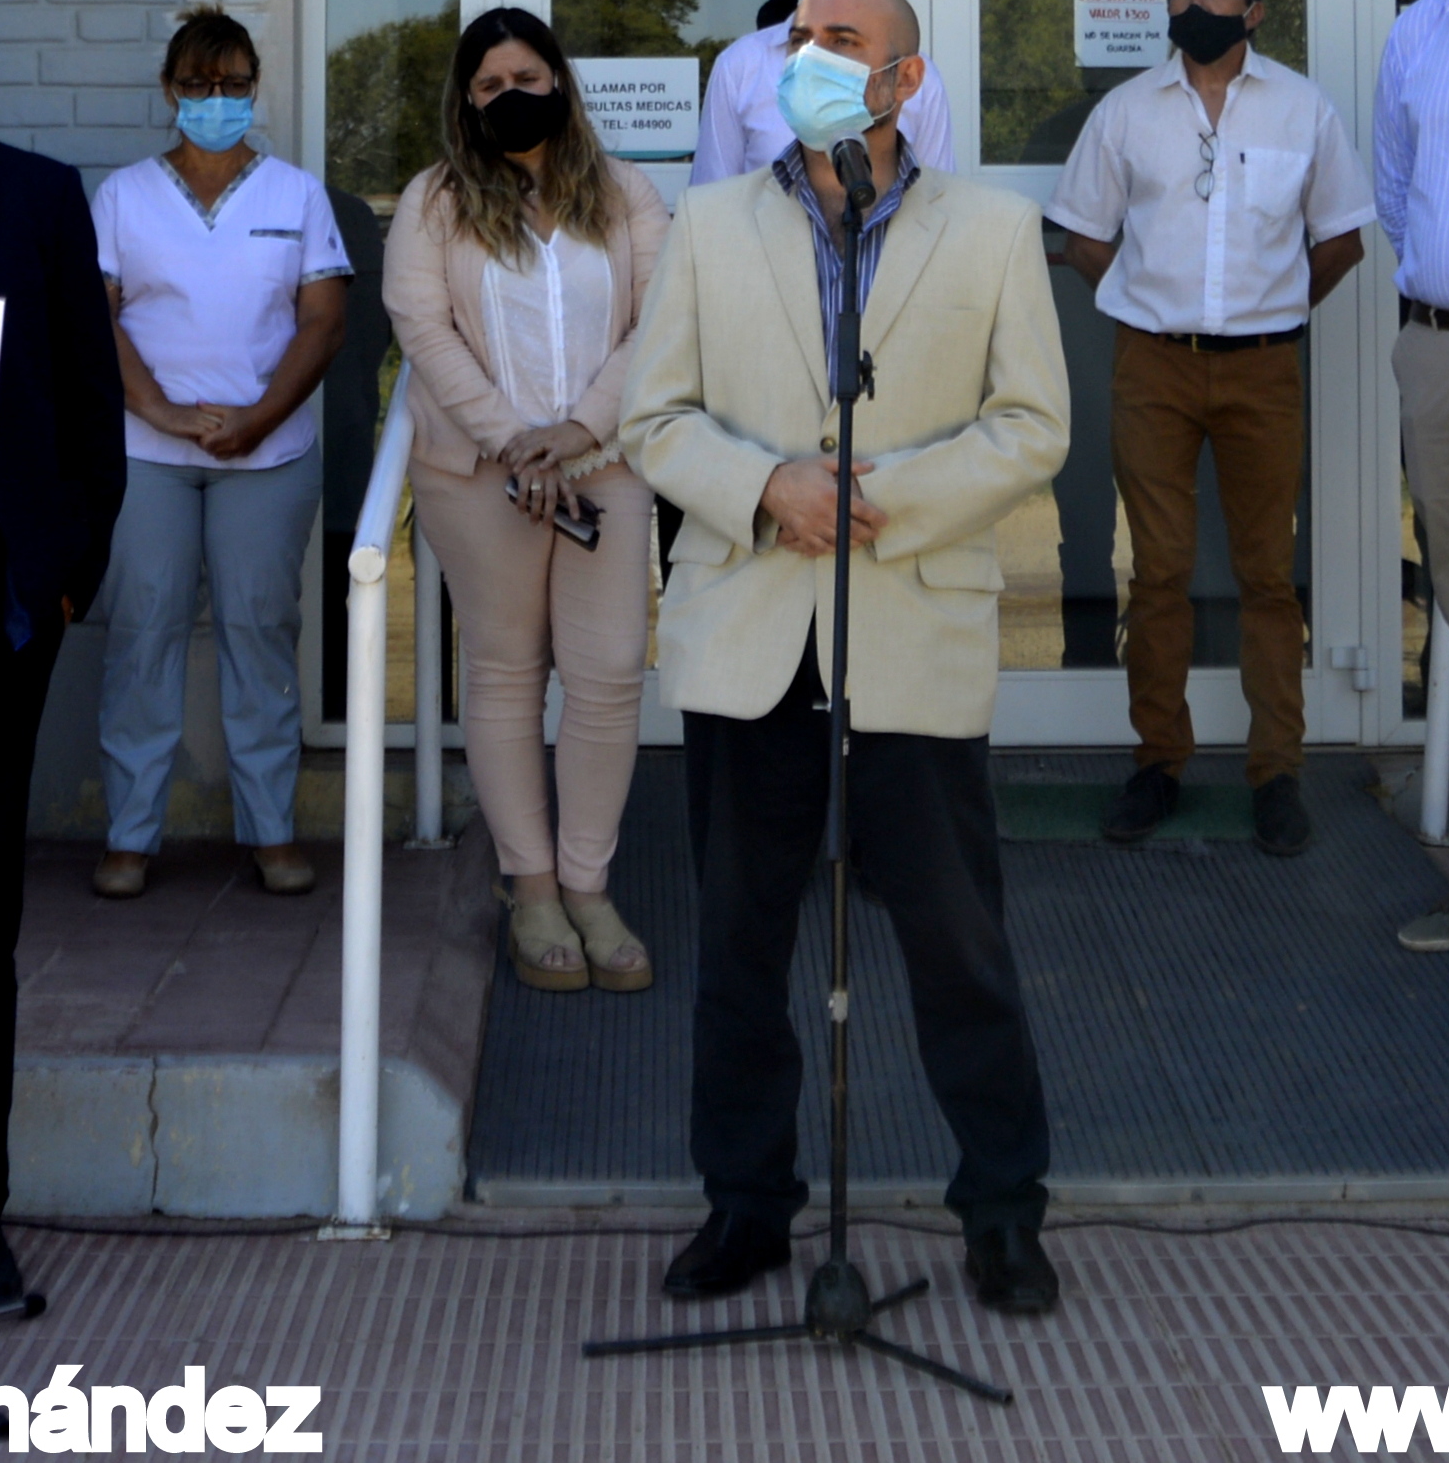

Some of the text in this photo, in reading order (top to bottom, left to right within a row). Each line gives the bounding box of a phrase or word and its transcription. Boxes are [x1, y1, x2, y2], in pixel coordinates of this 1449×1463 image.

[1088, 8, 1121, 20] VALOR
[1084, 31, 1096, 40] NO
[1100, 31, 1110, 40] SE
[1145, 31, 1160, 40] POR
[585, 83, 666, 94] LLAMAR POR
[583, 101, 692, 112] SULTAS MEDICAS
[601, 119, 628, 130] TEL:
[631, 119, 672, 130] 484900
